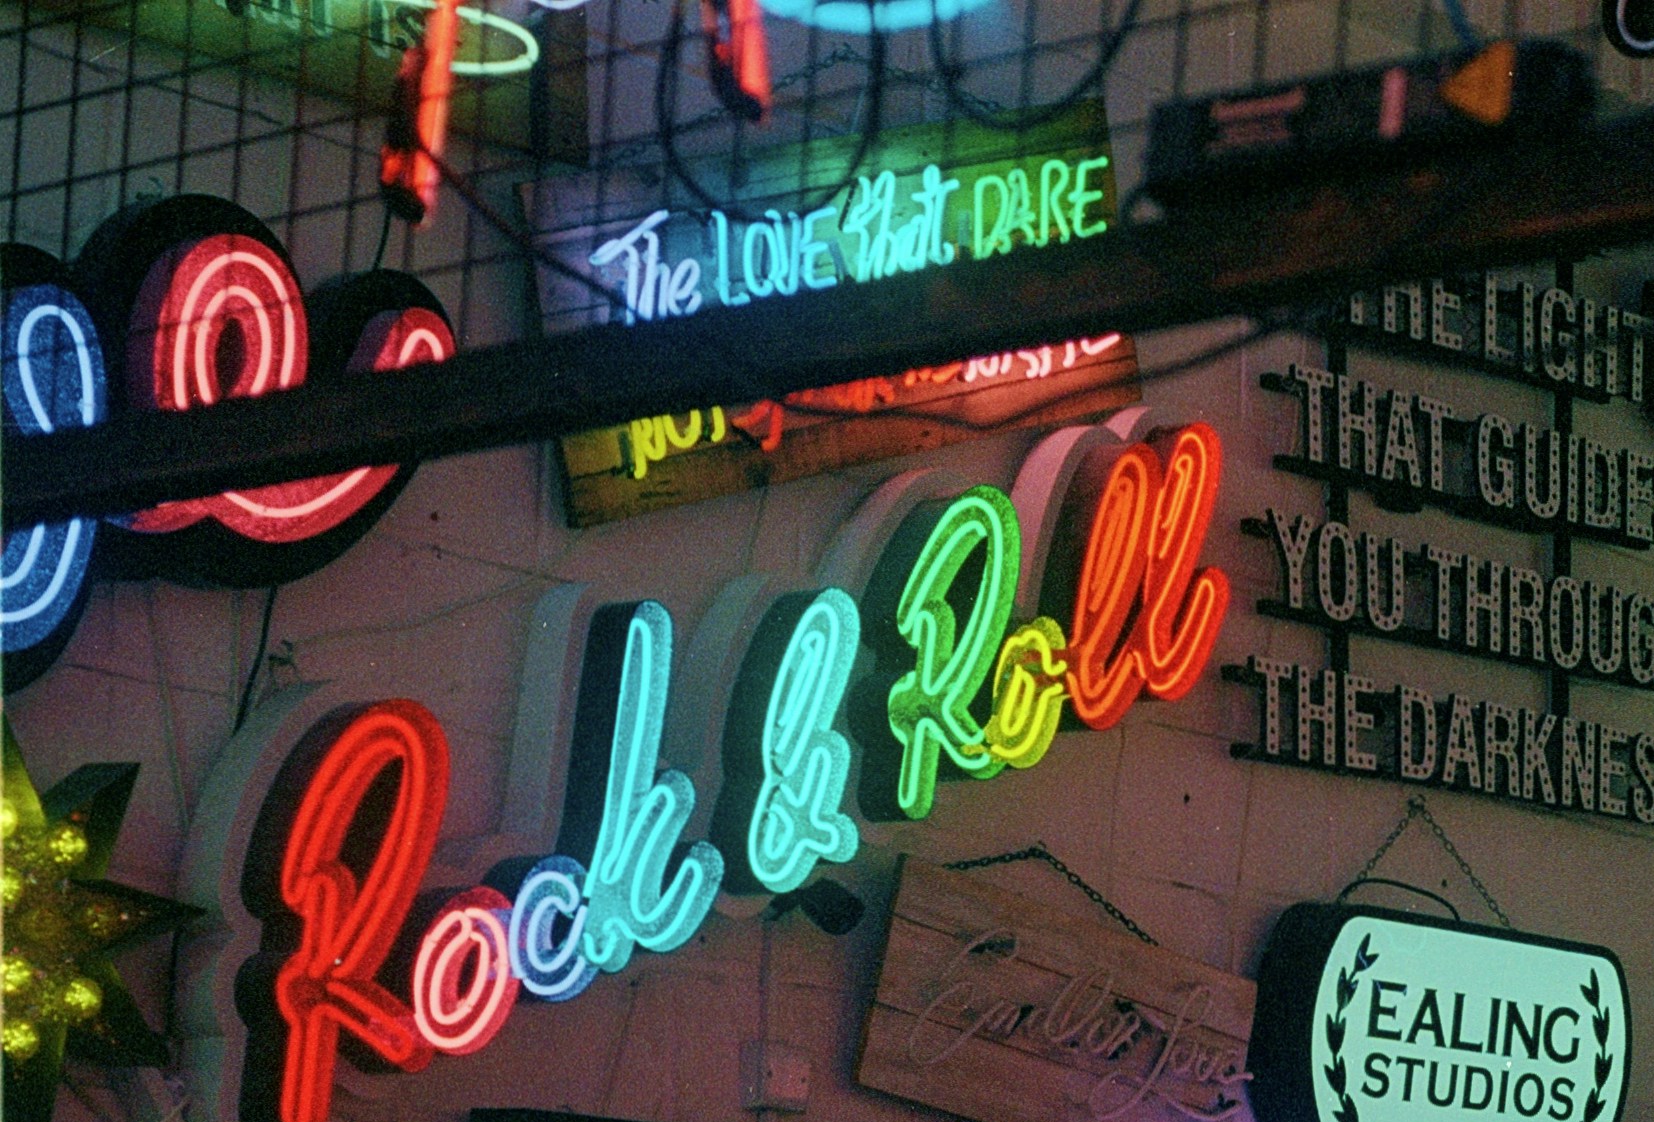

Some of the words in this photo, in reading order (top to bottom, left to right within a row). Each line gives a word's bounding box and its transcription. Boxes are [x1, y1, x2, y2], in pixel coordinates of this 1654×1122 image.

[590, 210, 701, 326] The
[711, 208, 838, 306] LOVE
[842, 164, 960, 283] that
[974, 157, 1108, 260] DARE
[1295, 363, 1455, 492] THAT
[887, 421, 1231, 821] Roll
[1268, 508, 1404, 632] YOU
[1252, 656, 1378, 772] THE
[1365, 981, 1583, 1063] EALING
[1361, 1053, 1577, 1122] STUDIOS
